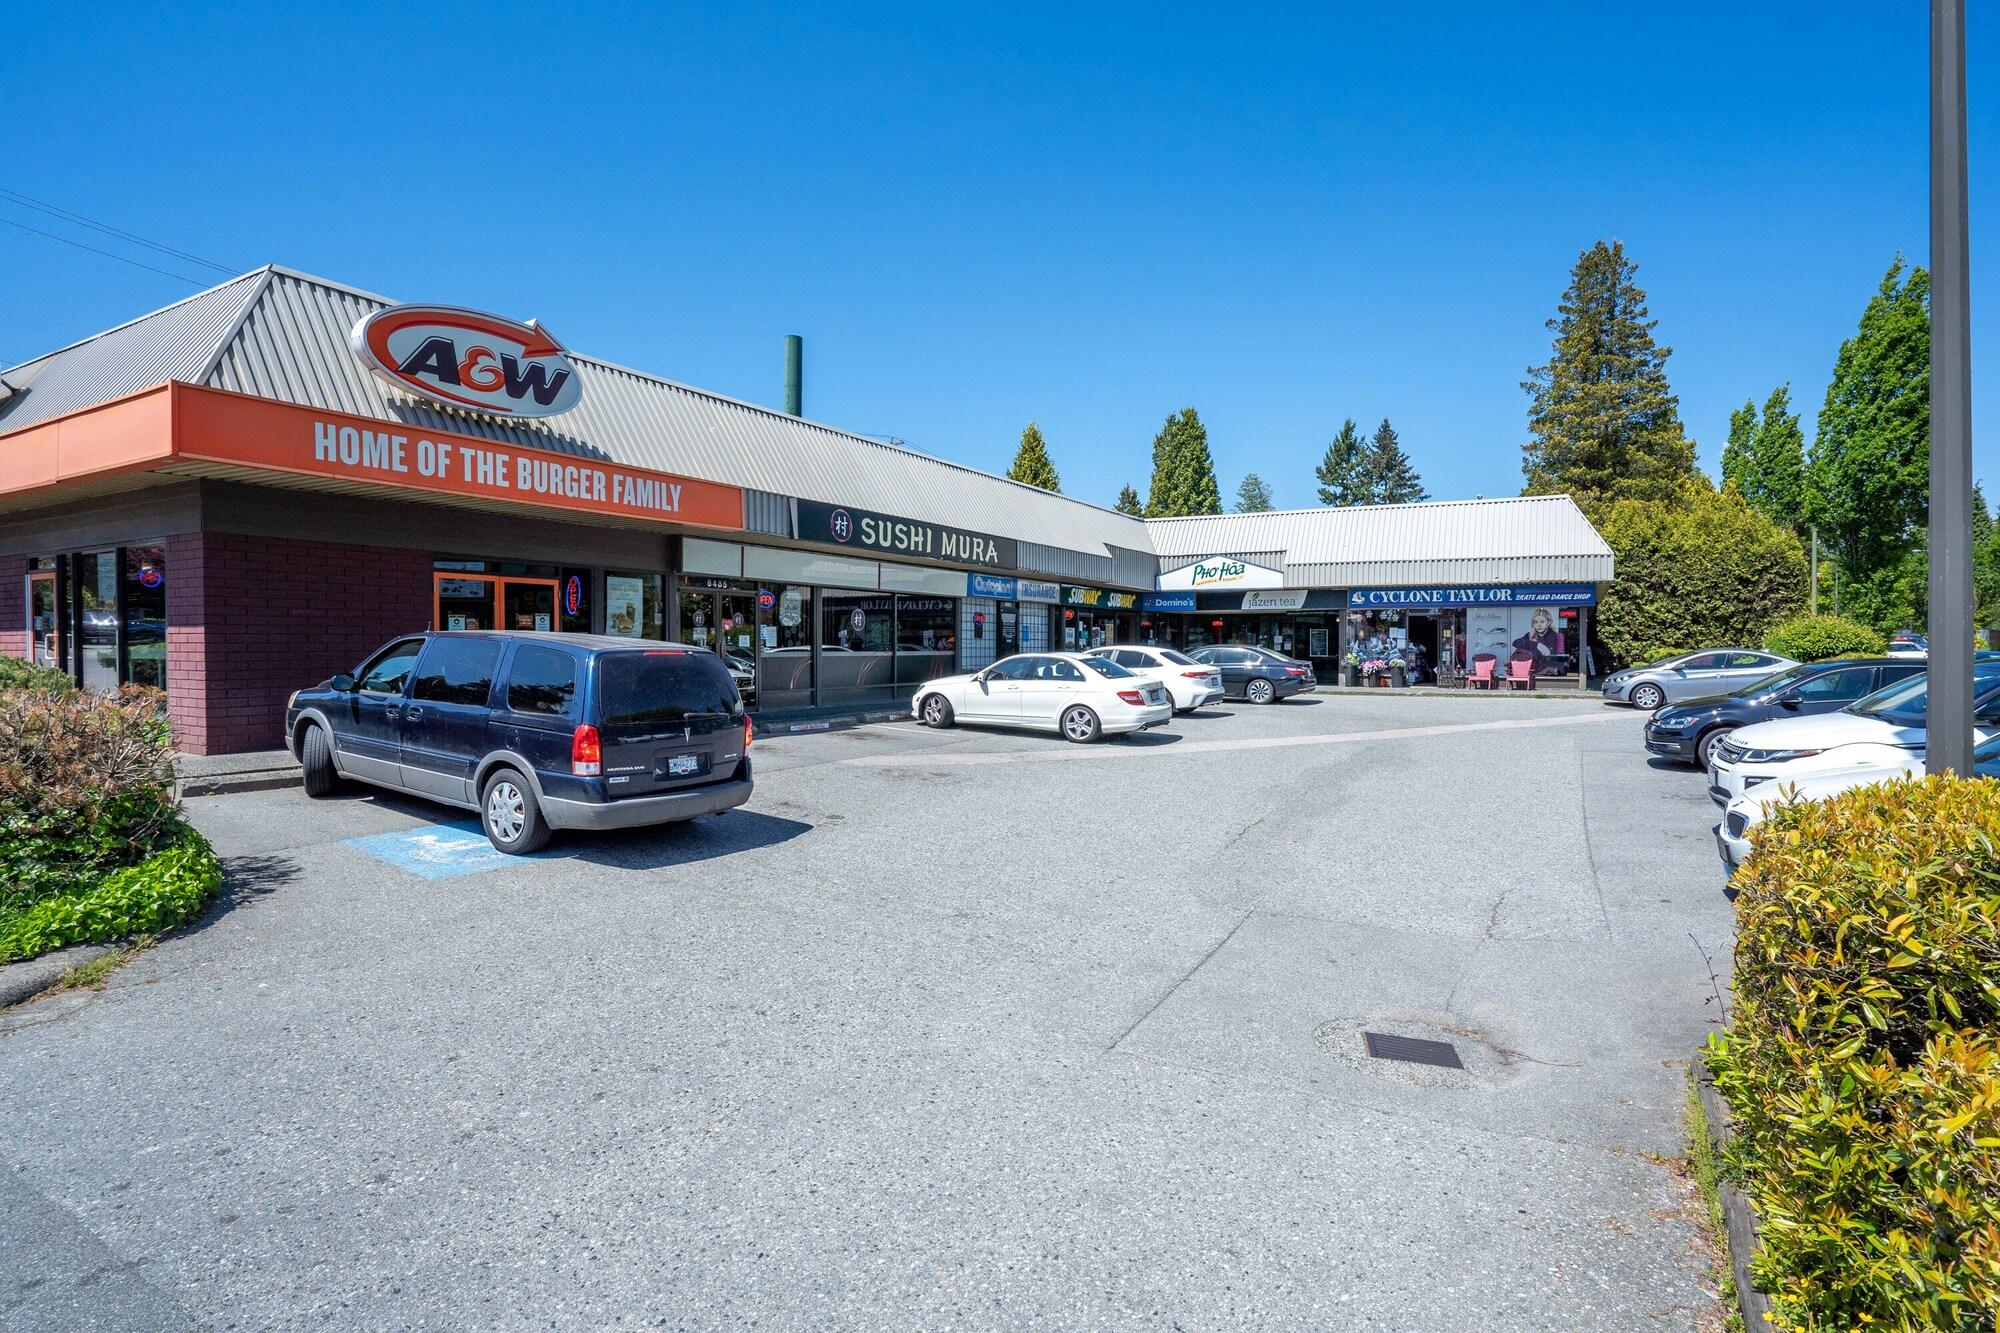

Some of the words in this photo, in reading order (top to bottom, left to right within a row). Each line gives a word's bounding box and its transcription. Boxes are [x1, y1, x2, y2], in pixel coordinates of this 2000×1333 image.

[398, 335, 570, 406] A&W
[314, 421, 408, 473] HOME
[417, 439, 452, 478] OF
[460, 446, 510, 488] THE
[517, 457, 606, 502] BURGER
[613, 473, 682, 513] FAMILY
[861, 517, 932, 553] SUSHI
[942, 531, 998, 564] MURA
[707, 579, 728, 589] 6485
[1021, 583, 1056, 599] INSURANCE
[1069, 587, 1101, 605] SUBWAY
[1108, 592, 1136, 609] SUBWAY
[1155, 598, 1194, 607] Domino's
[1279, 597, 1296, 606] tea
[1369, 590, 1443, 604] CYCLONE
[1447, 588, 1512, 602] TAYLOR
